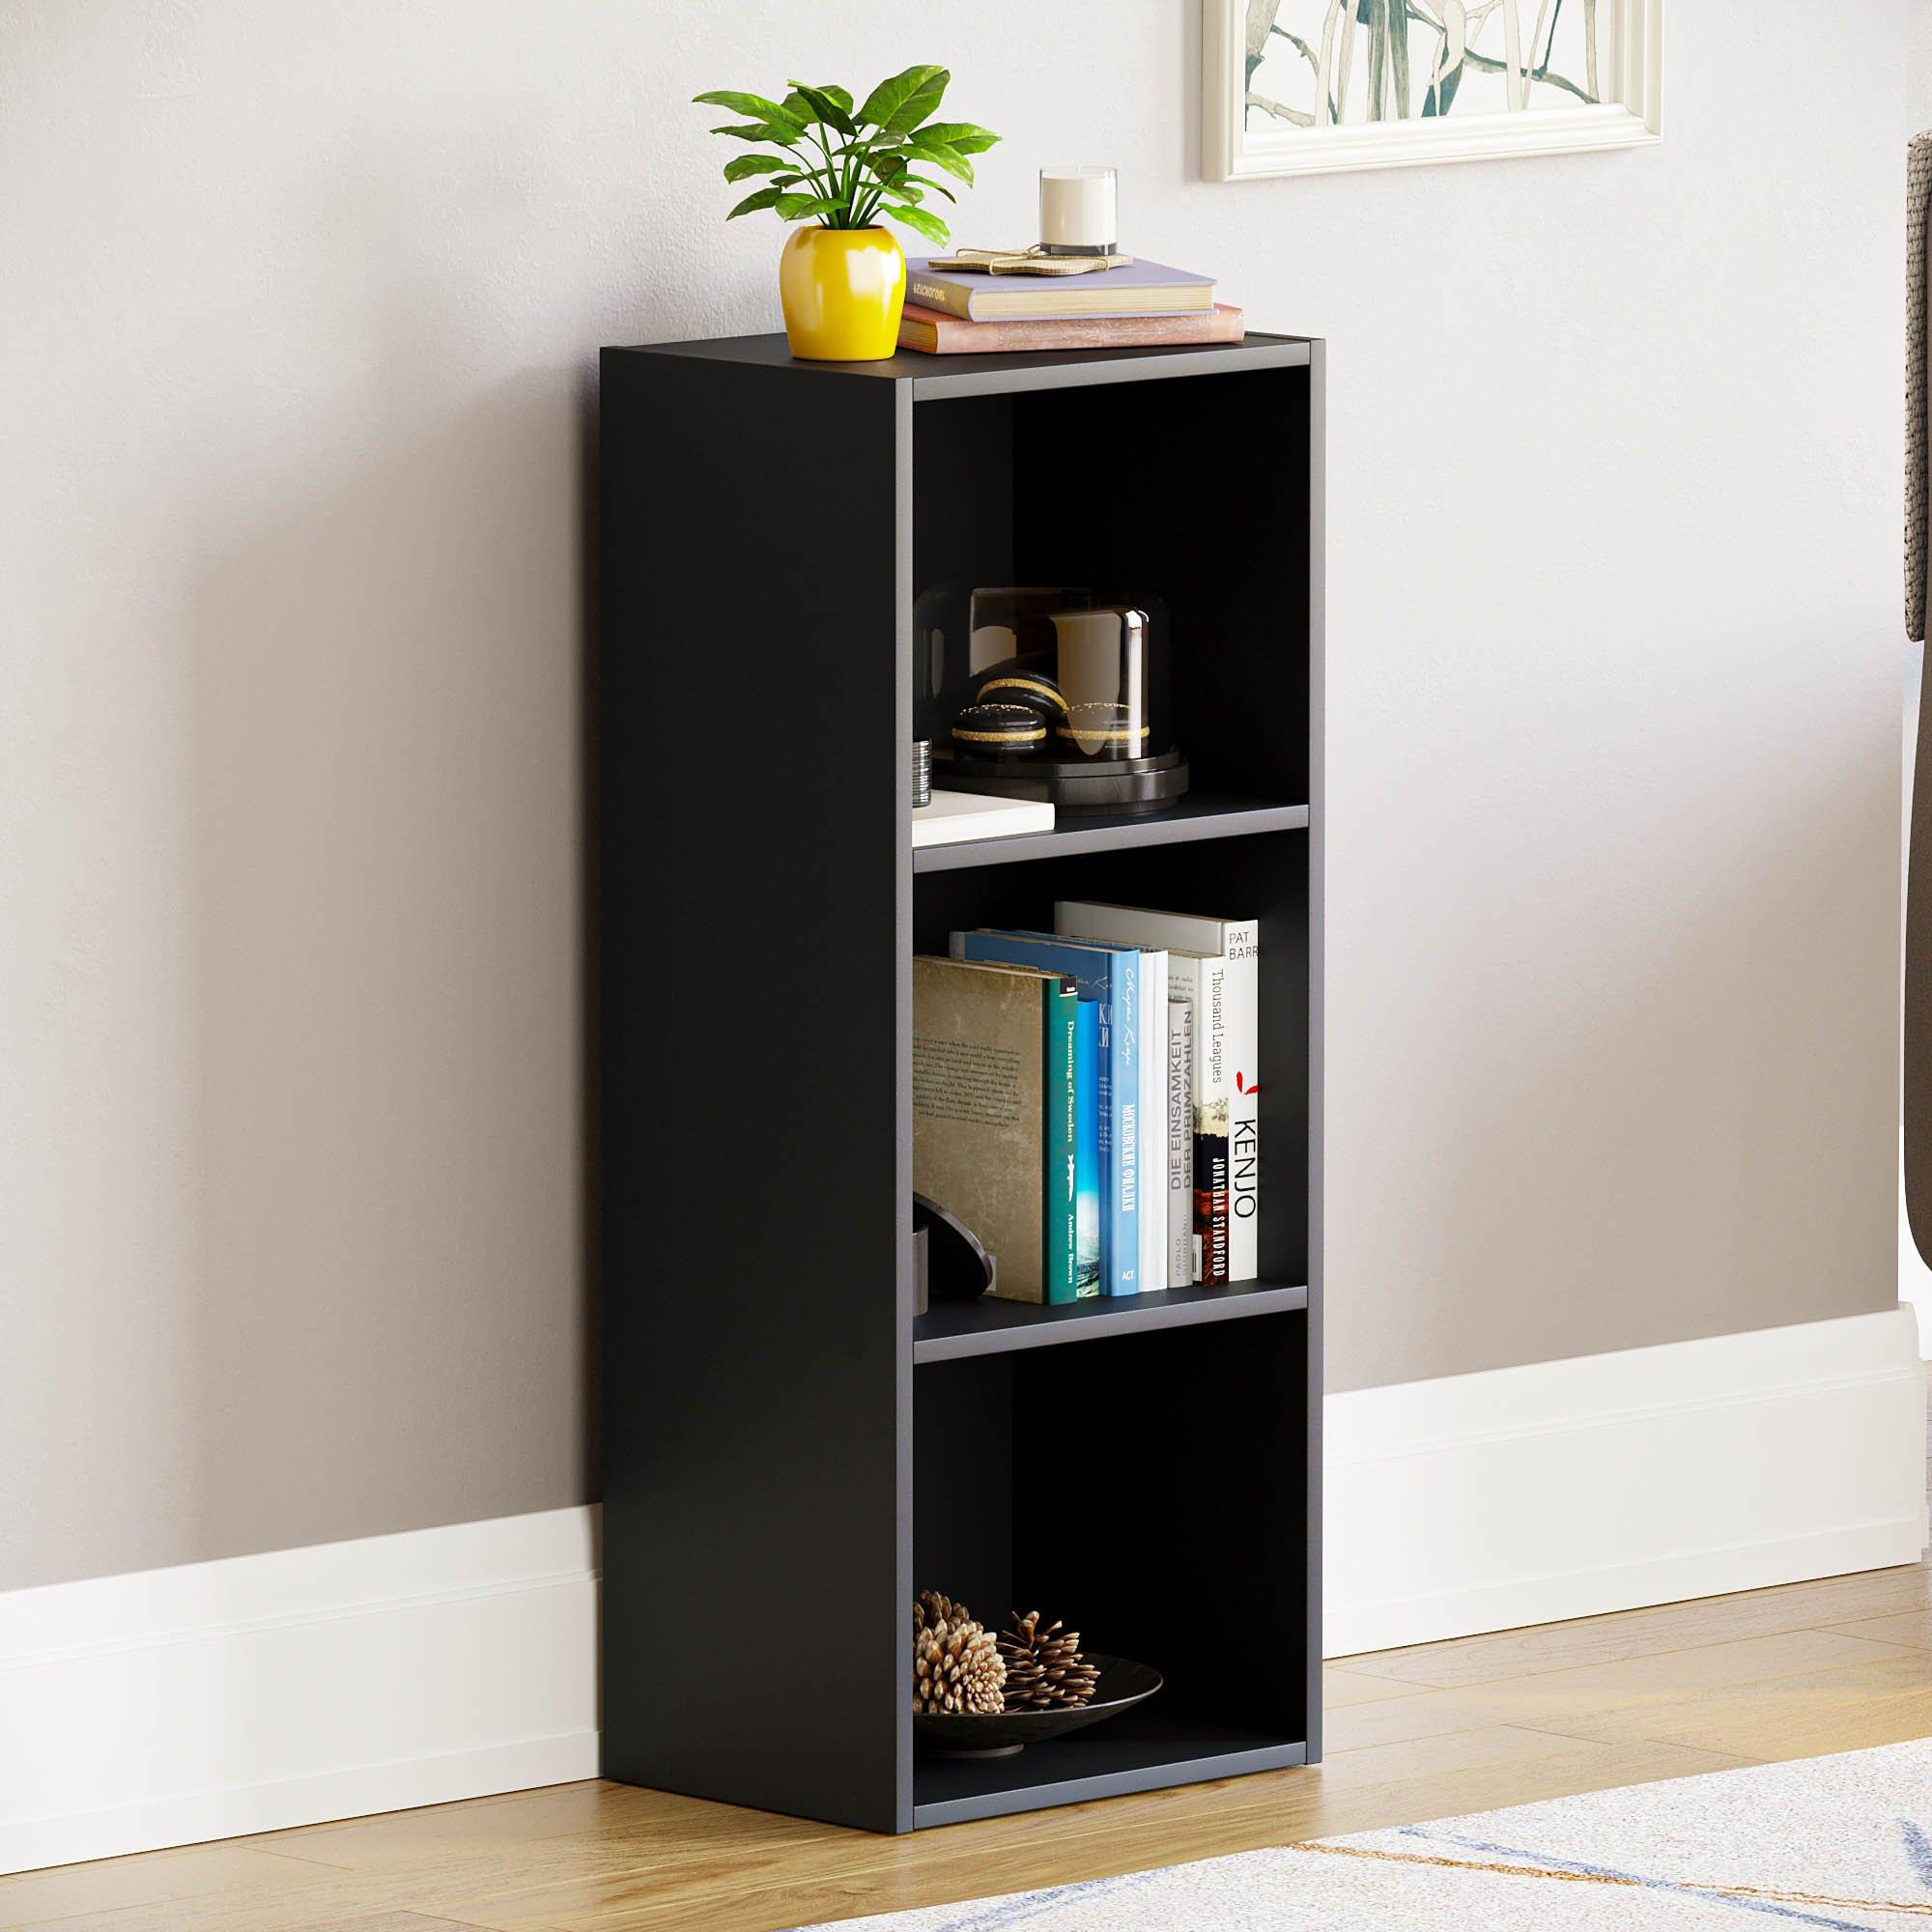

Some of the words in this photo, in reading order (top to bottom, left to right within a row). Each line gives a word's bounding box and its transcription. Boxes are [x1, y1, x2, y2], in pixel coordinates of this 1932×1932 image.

[1229, 931, 1249, 944] PAT
[1212, 969, 1224, 1031] Thousand
[1209, 1034, 1224, 1083] Leagues
[1067, 1081, 1074, 1094] of
[1171, 1030, 1181, 1151] EINSAMKEIT
[1122, 1103, 1136, 1167] МОСКОВСКИЕ
[1122, 1169, 1136, 1212] ФИАЛКИ
[1171, 1157, 1181, 1190] DIE
[1212, 1157, 1225, 1211] JONATHAN
[1235, 1119, 1256, 1218] KENJO
[1212, 1216, 1225, 1276] STANDFORD
